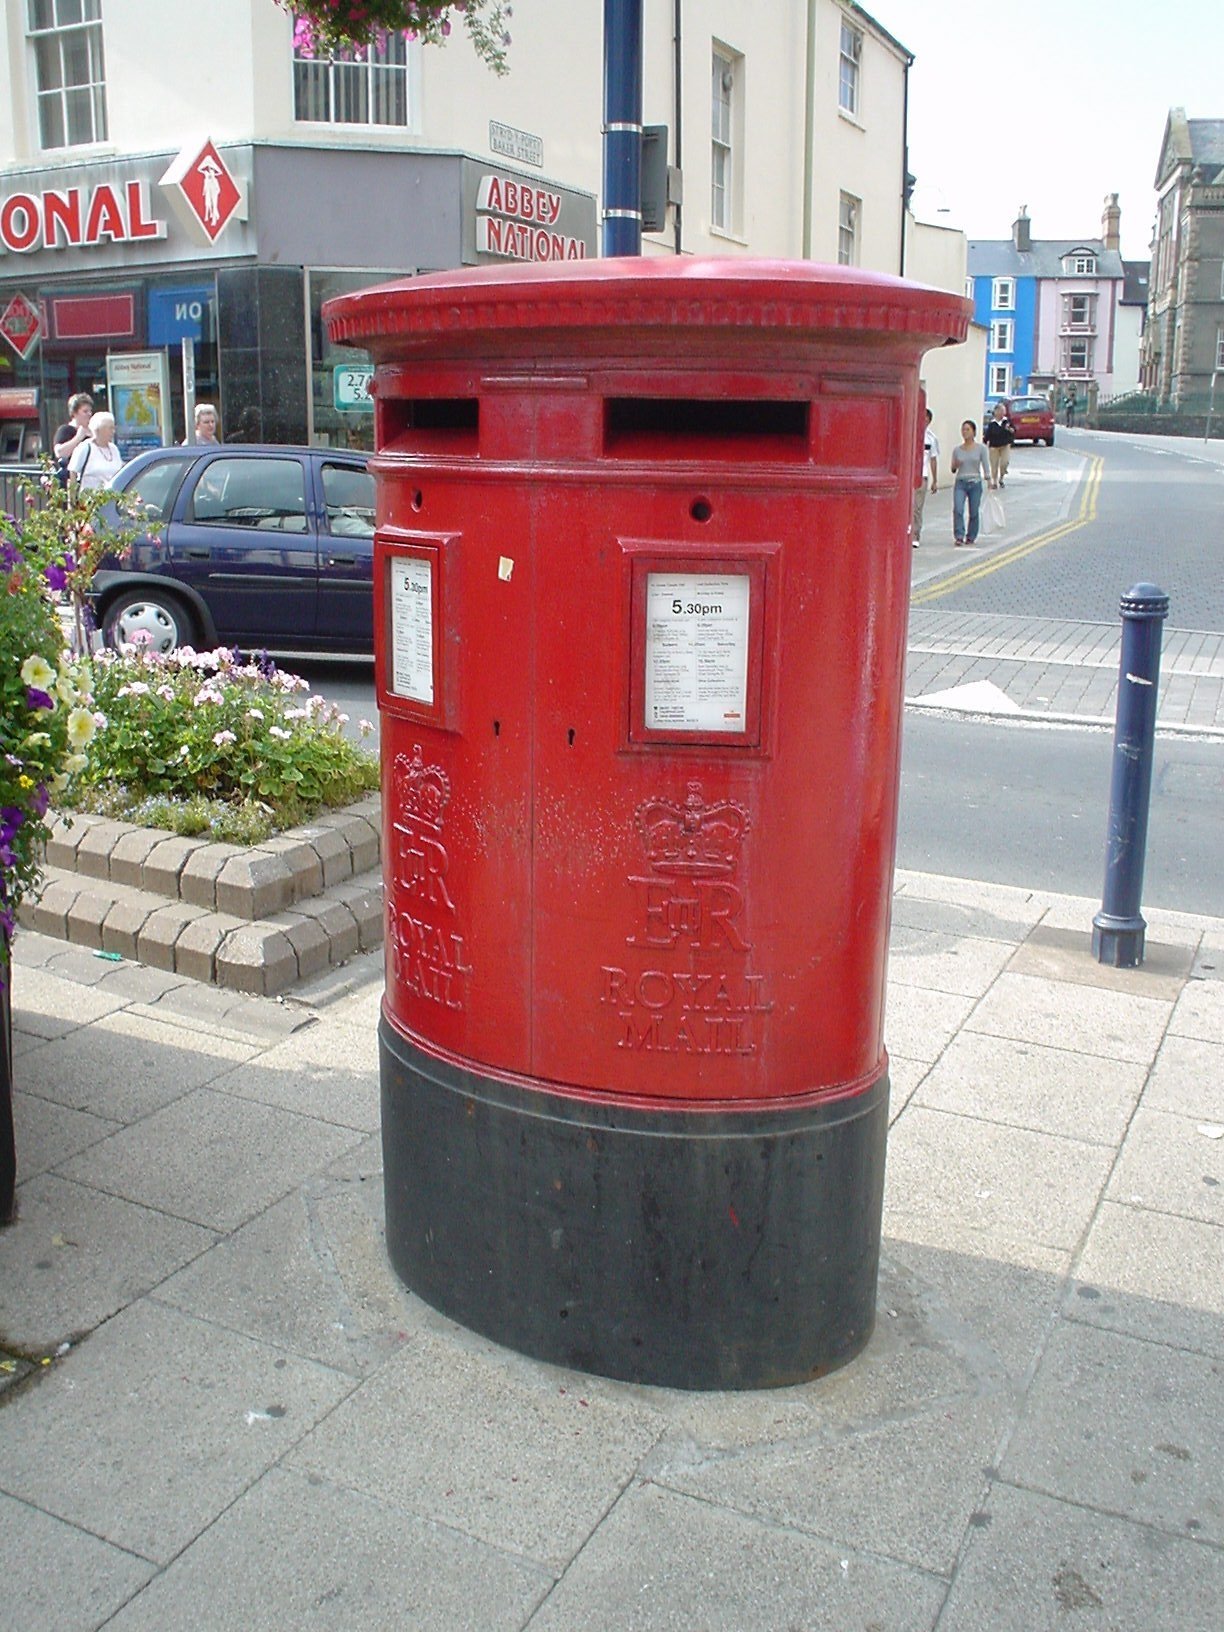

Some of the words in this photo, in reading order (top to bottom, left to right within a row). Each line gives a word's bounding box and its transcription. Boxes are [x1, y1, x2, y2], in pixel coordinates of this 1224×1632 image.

[492, 137, 515, 155] BAKER
[517, 147, 540, 164] STREET
[0, 180, 158, 252] ONAL
[487, 176, 560, 225] ABBEY
[347, 374, 372, 387] 2.7
[671, 599, 723, 616] 5.30pm
[388, 901, 474, 976] ROYAL
[393, 943, 464, 1010] MAIL
[598, 965, 776, 1013] ROYAL
[617, 1010, 757, 1057] MAIL
